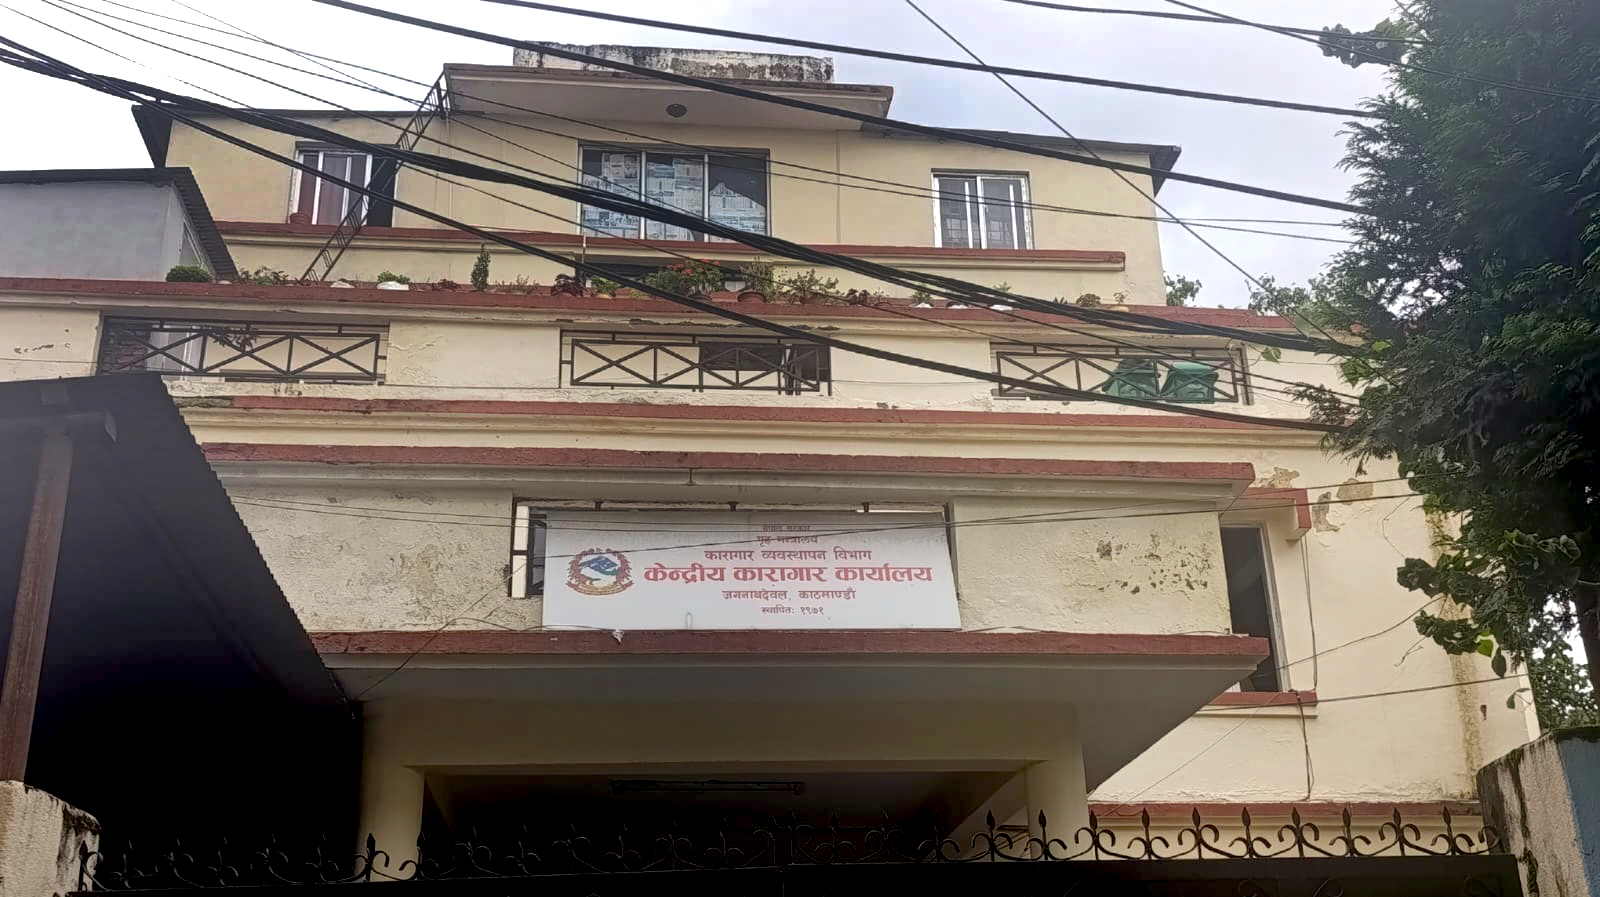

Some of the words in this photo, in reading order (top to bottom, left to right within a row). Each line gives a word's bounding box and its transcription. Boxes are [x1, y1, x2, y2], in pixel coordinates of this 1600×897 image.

[704, 550, 755, 560] कारागार
[761, 550, 827, 560] व्यवस्थापन
[833, 546, 873, 560] विभाग
[644, 562, 727, 584] केन्द्रीय
[733, 567, 829, 582] कारागार
[834, 563, 933, 582] कार्यालय
[799, 606, 825, 615] १९७१
